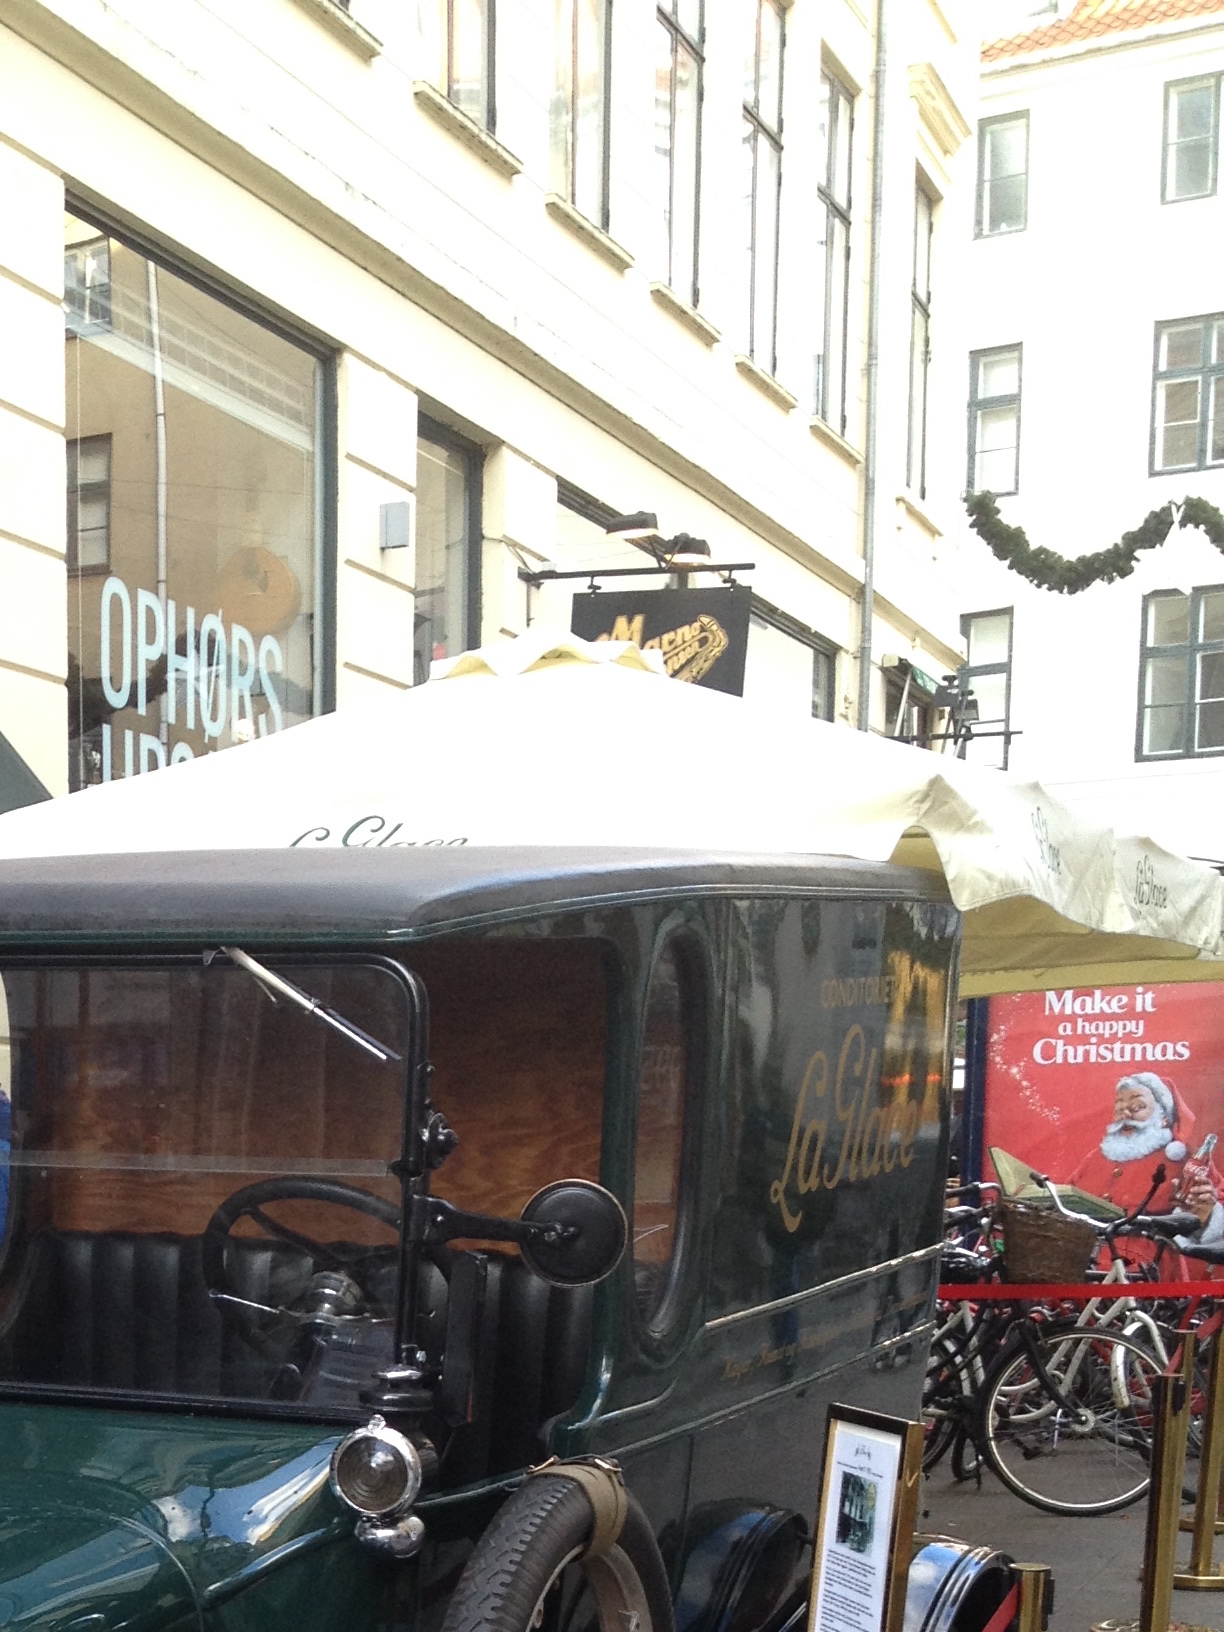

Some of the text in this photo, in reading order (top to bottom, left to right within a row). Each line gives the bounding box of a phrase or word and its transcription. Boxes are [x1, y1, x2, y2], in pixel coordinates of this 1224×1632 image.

[1045, 986, 1157, 1016] Make it
[1058, 1017, 1145, 1038] a happy
[1032, 1036, 1191, 1065] Christmas
